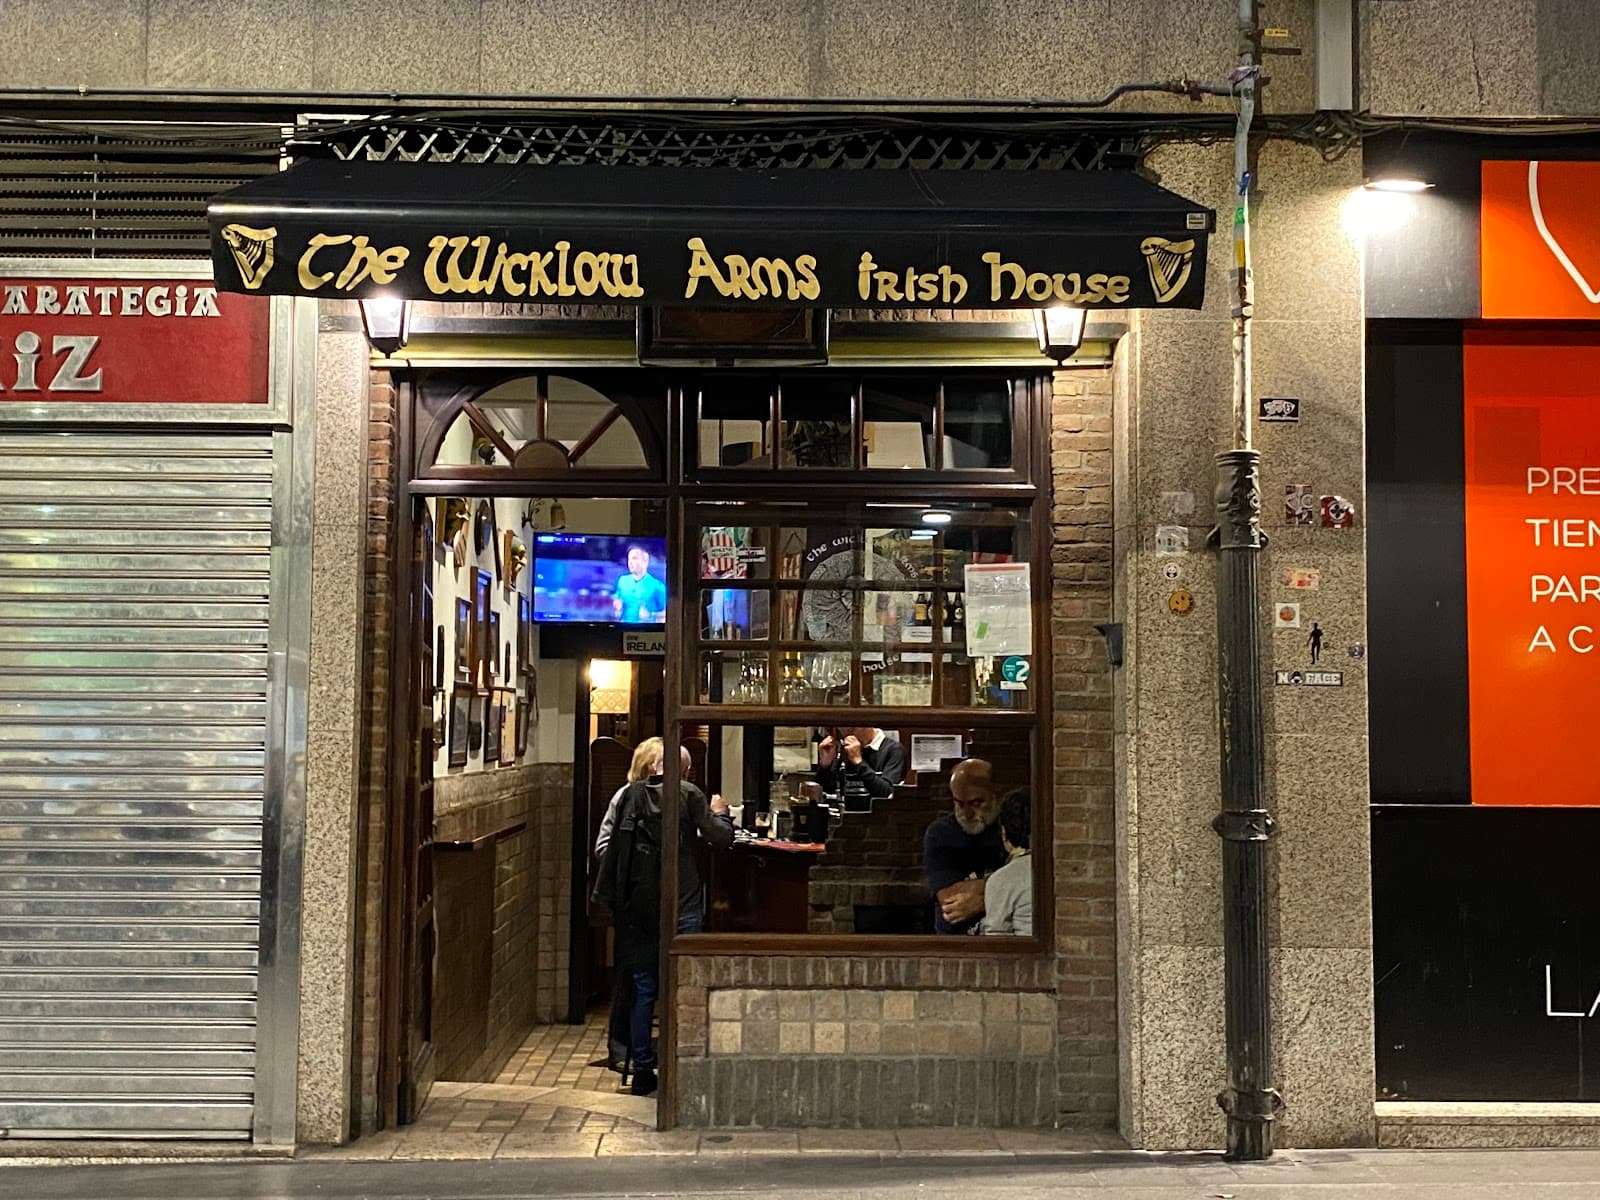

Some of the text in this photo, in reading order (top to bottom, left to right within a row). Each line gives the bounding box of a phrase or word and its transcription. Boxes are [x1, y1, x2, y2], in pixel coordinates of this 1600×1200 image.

[298, 233, 410, 291] The
[424, 235, 644, 298] Wicklow
[685, 237, 821, 300] Arms
[1527, 466, 1600, 495] PRE
[1531, 575, 1600, 603] PAR
[1528, 625, 1556, 653] A
[1015, 660, 1030, 682] 2
[1545, 964, 1600, 1018] L
